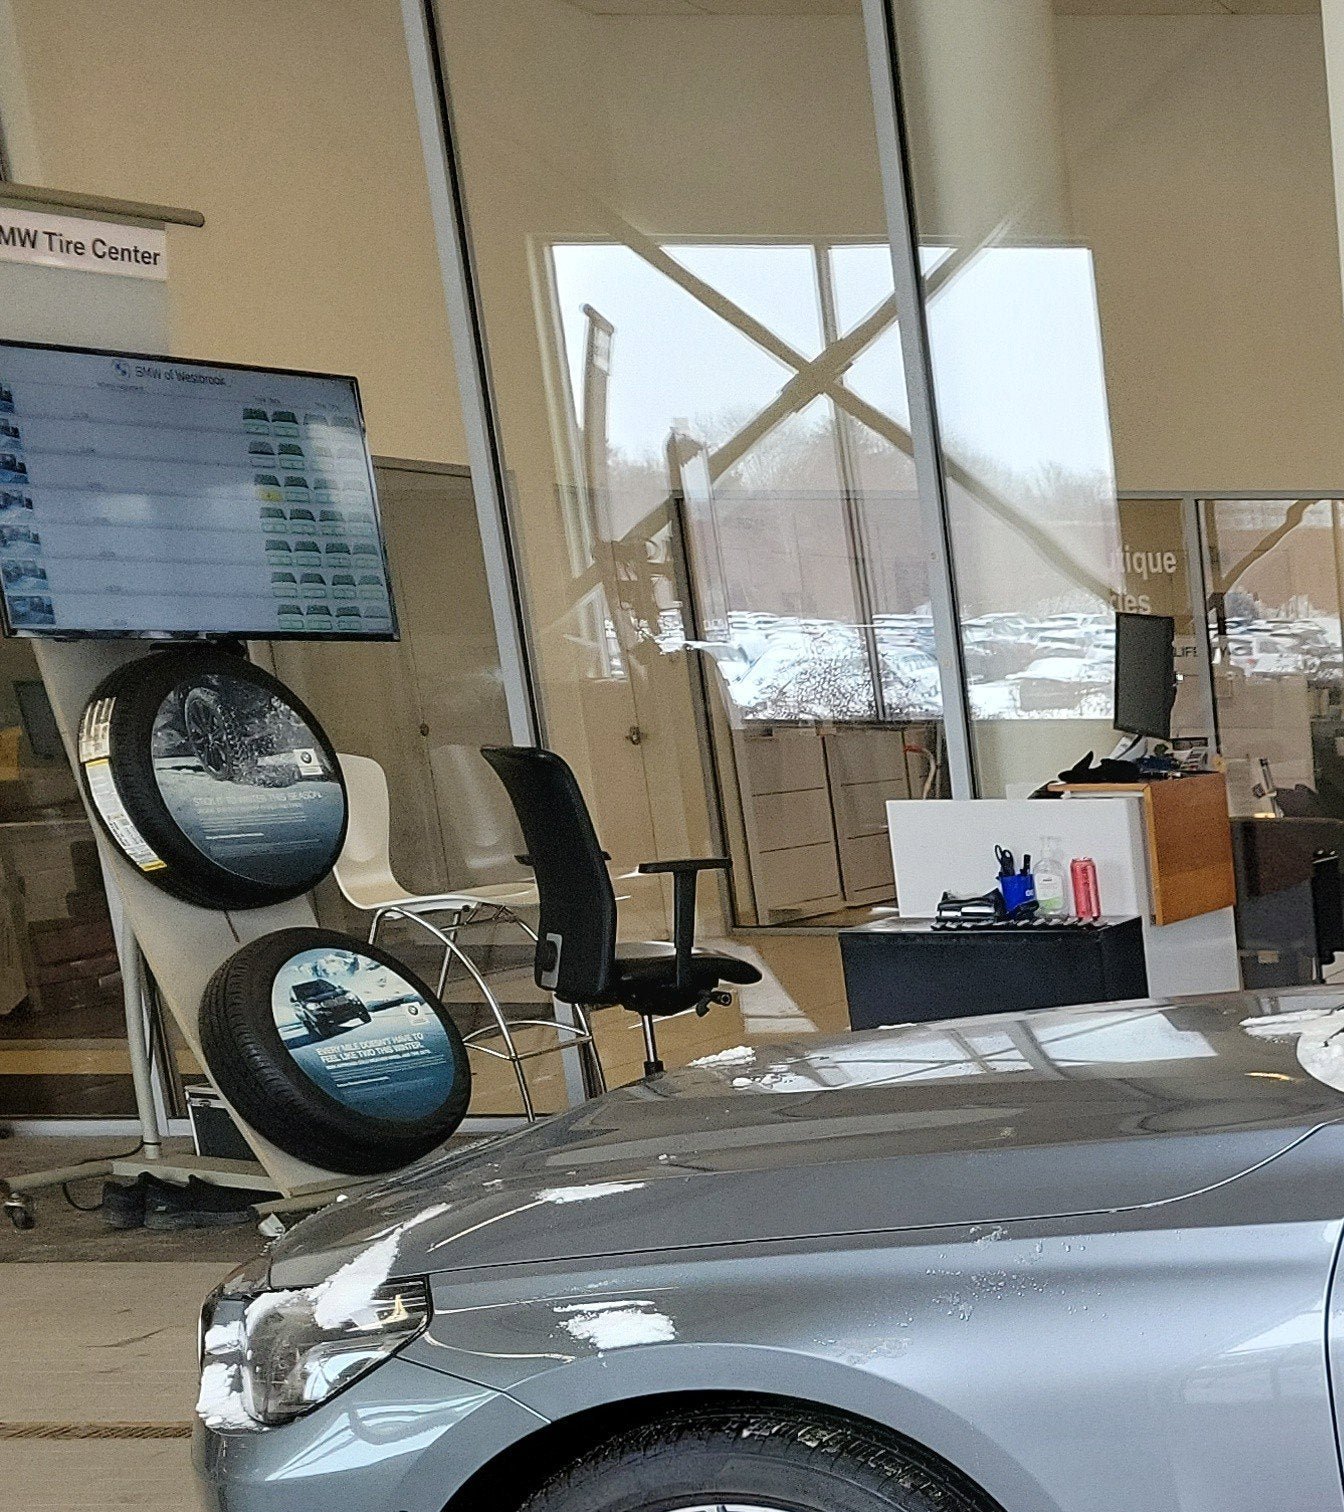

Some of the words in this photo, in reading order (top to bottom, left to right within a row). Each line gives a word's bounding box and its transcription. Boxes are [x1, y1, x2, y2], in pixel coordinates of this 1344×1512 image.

[0, 224, 38, 249] MW
[42, 231, 86, 256] Tire
[91, 237, 161, 266] Center
